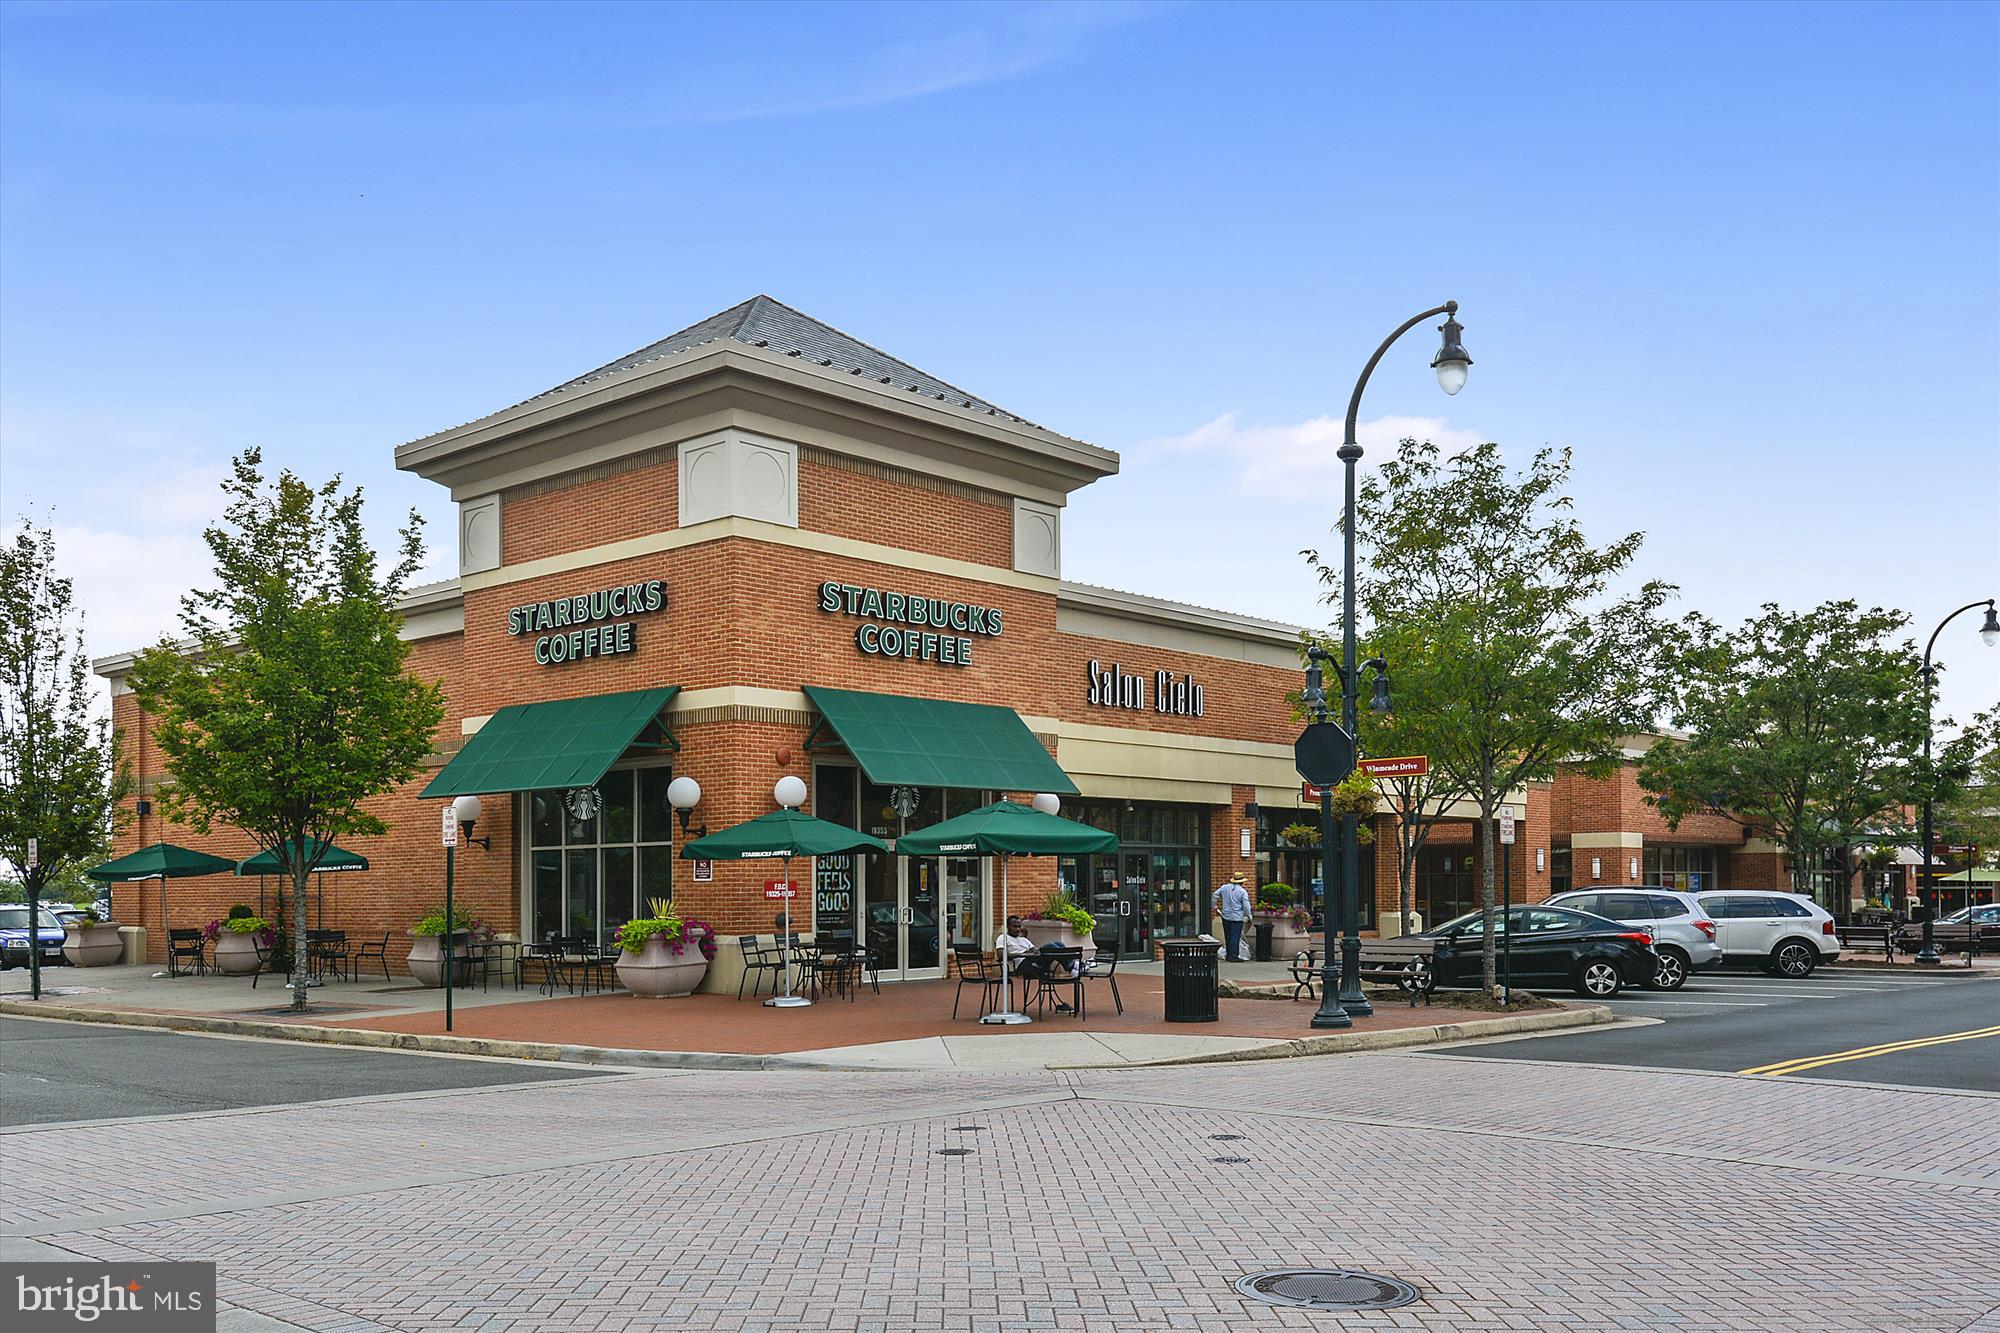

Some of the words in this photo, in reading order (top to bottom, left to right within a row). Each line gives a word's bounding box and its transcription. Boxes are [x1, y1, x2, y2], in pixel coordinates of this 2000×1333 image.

[508, 580, 665, 635] STARBUCKS
[819, 581, 1003, 636] STARBUCKS
[535, 622, 634, 665] COFFEE
[856, 624, 973, 665] COFFEE
[1088, 660, 1144, 709] Salon
[1155, 670, 1203, 717] Cielo
[1400, 762, 1418, 770] Drive
[817, 871, 851, 890] FEELS
[817, 892, 850, 911] GOOD
